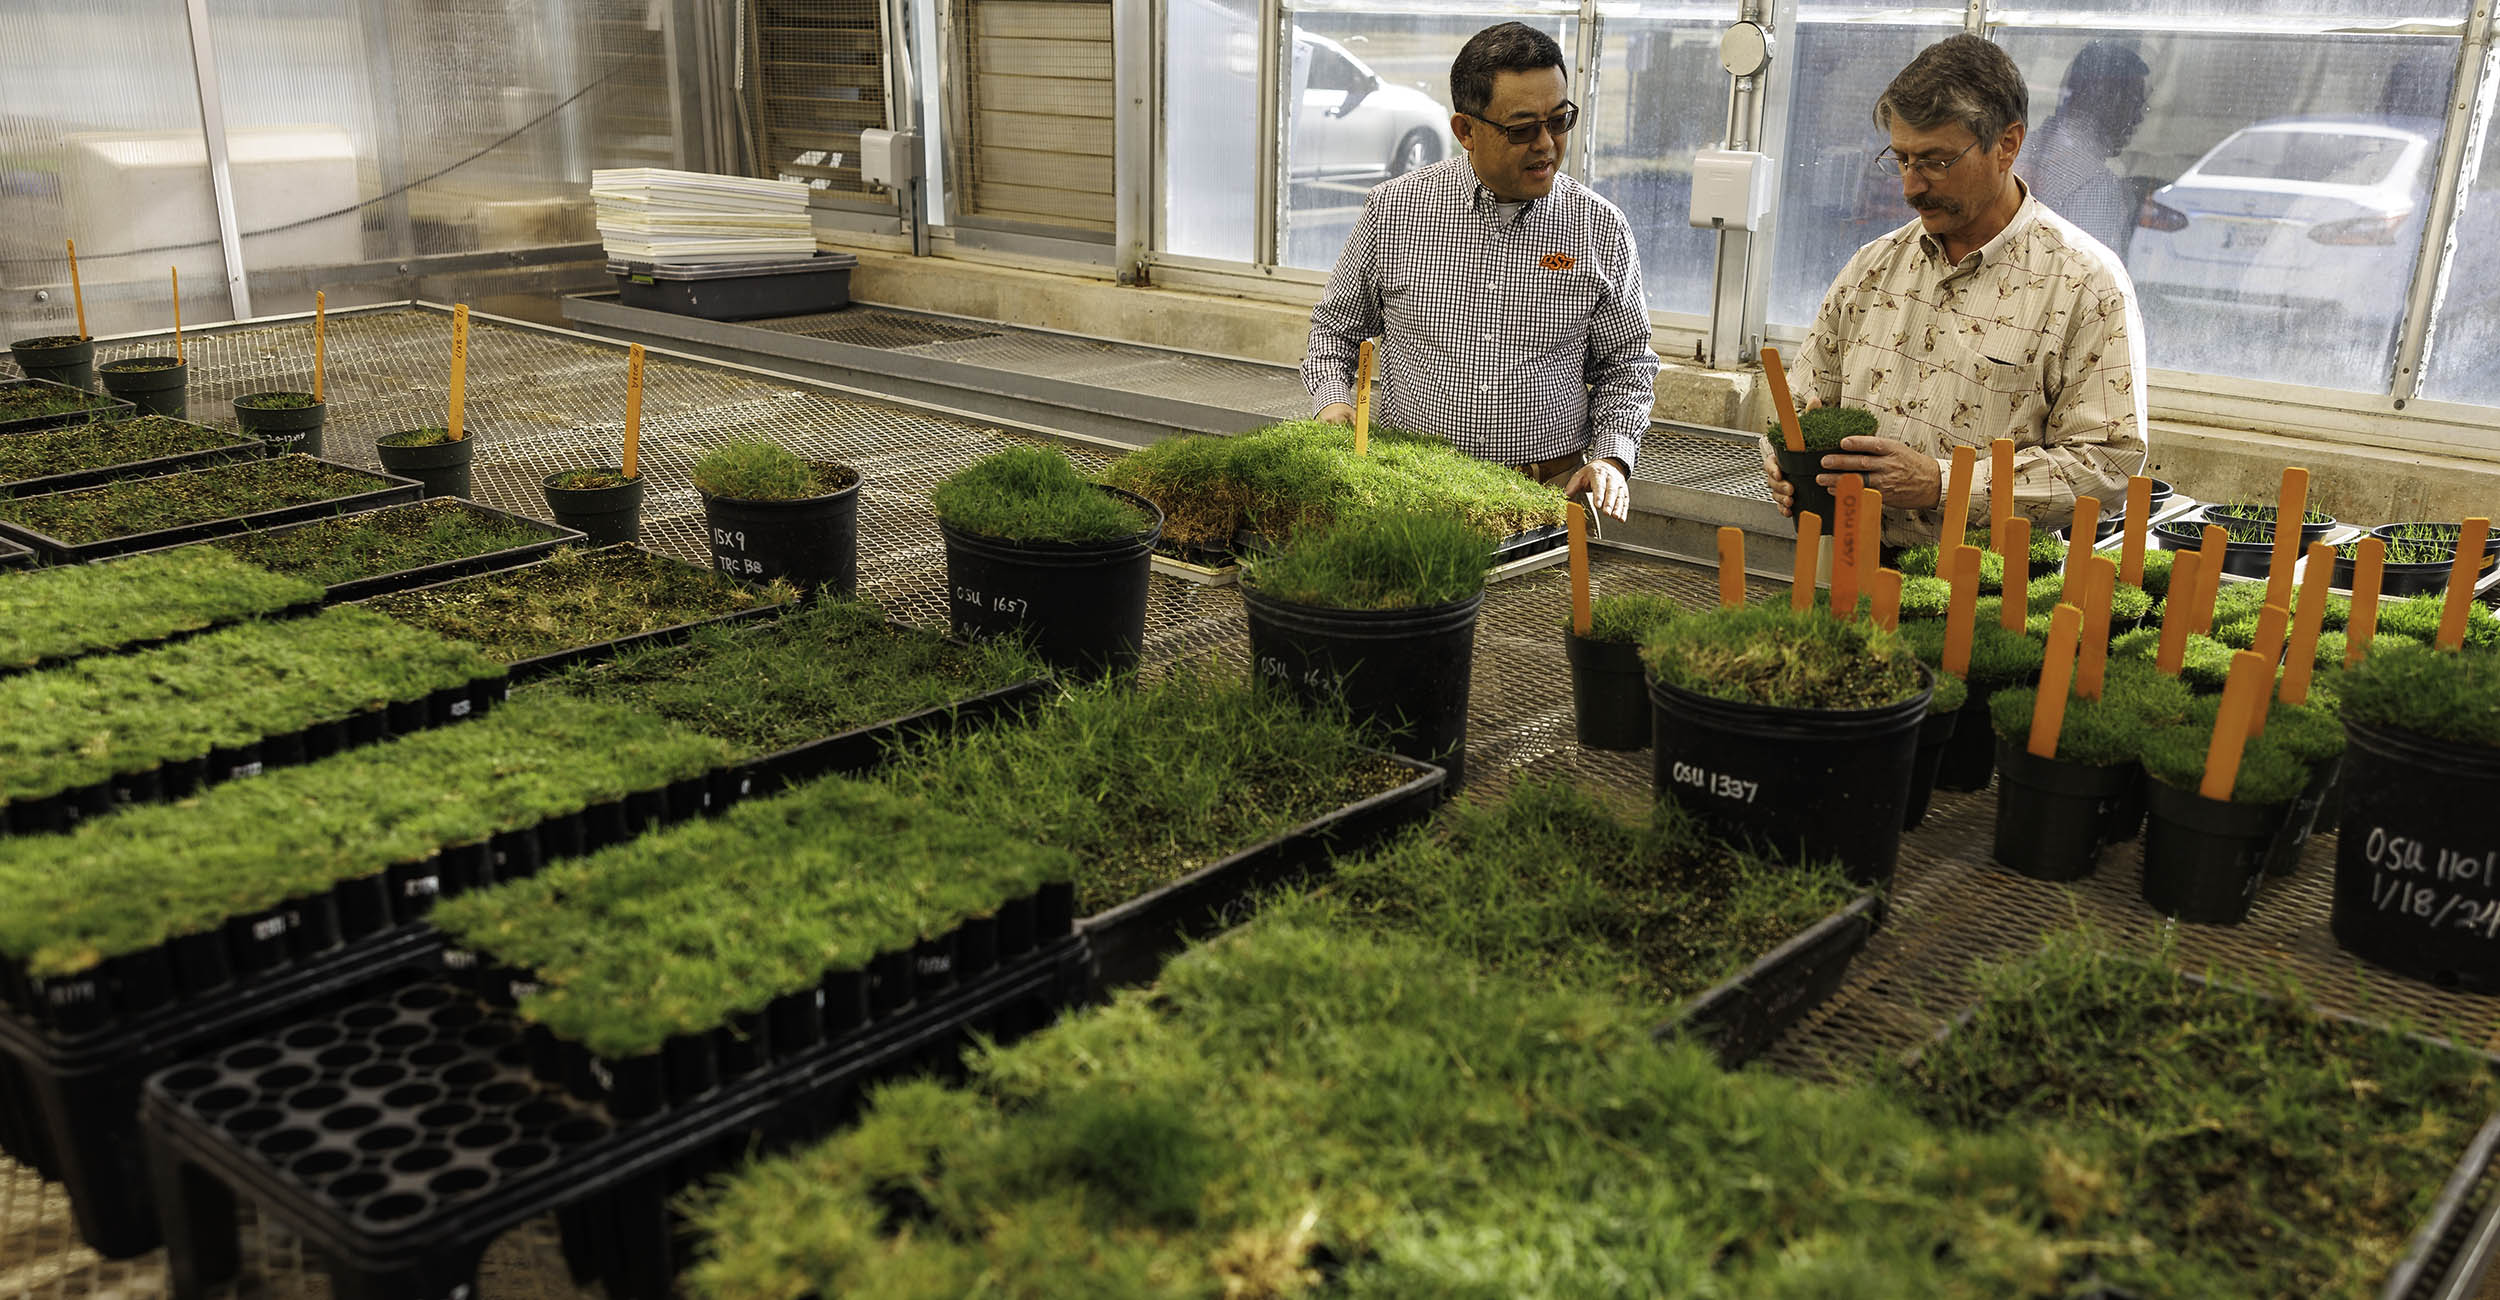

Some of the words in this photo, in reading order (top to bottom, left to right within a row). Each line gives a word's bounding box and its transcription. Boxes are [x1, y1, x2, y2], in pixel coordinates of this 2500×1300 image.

[1539, 252, 1576, 270] OSU
[956, 586, 982, 607] OSU
[993, 597, 1028, 619] 1657
[1673, 761, 1704, 787] OSU
[1710, 772, 1759, 804] 1337
[2366, 827, 2426, 872] OSU
